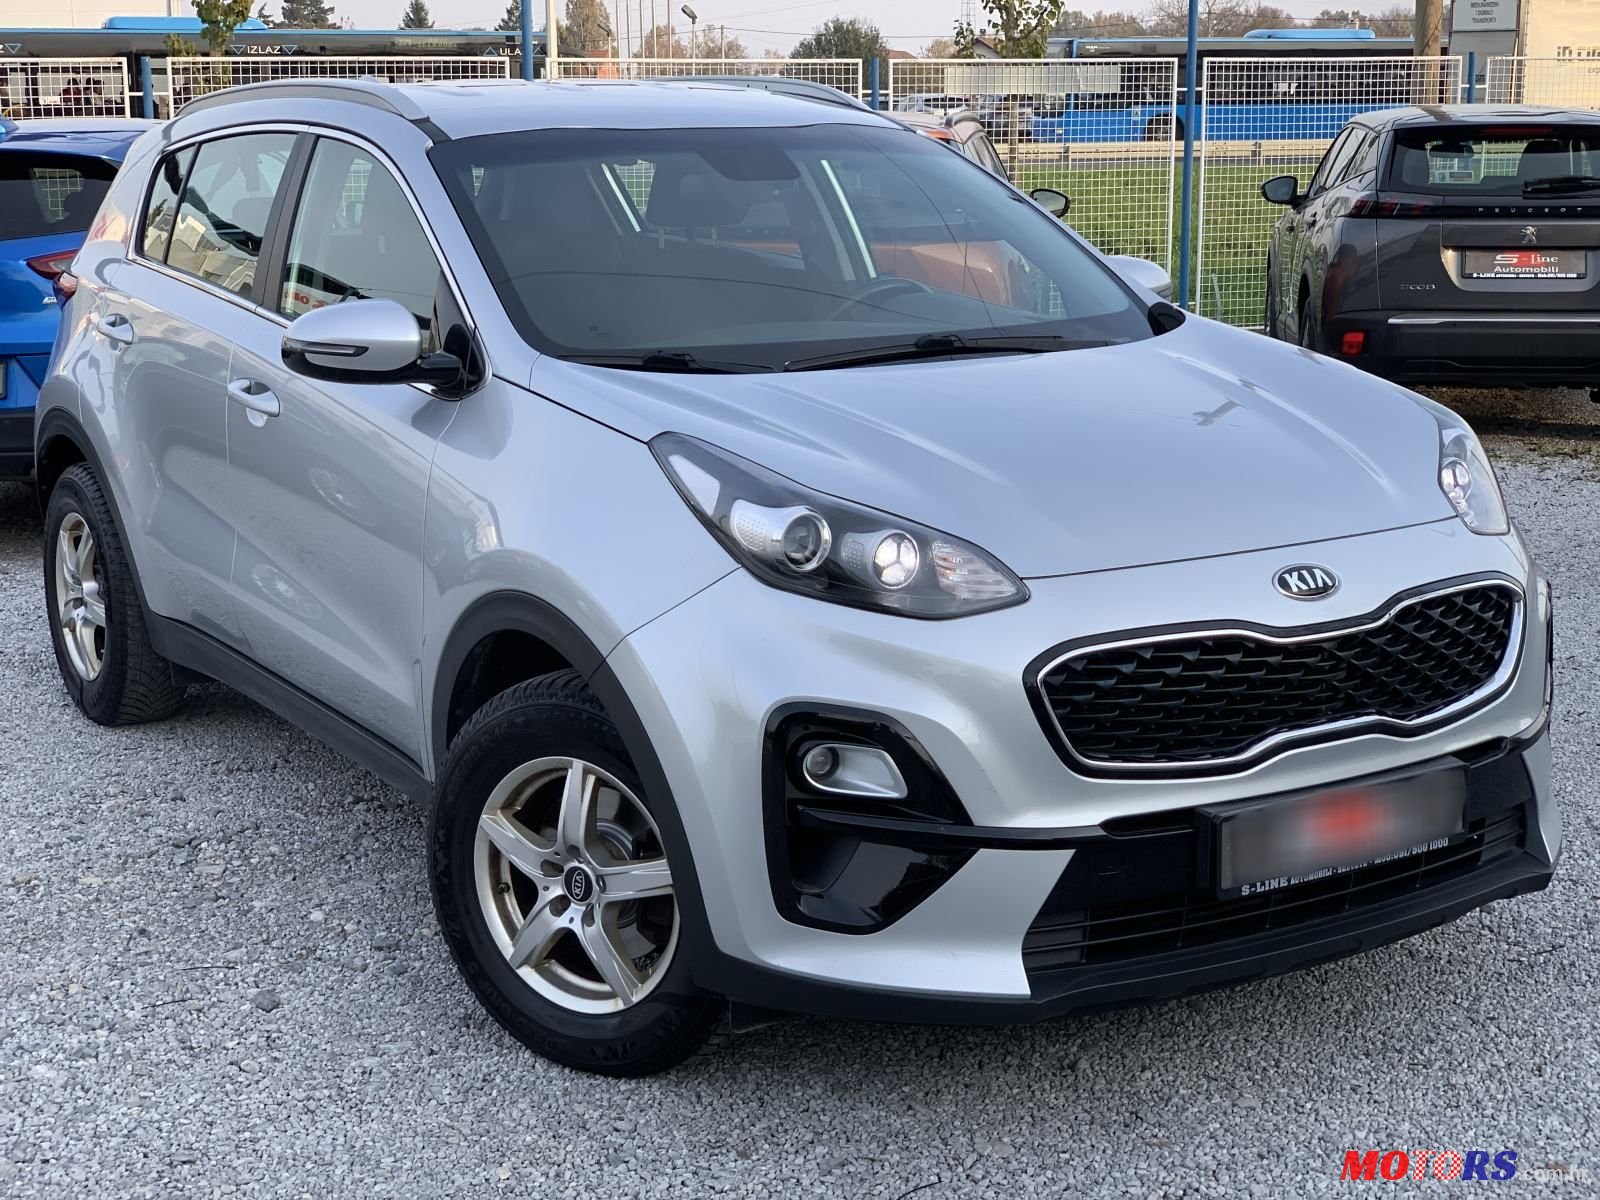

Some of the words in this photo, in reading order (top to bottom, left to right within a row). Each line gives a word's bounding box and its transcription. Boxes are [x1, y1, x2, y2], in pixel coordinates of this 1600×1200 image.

[247, 45, 281, 54] IZLAZ
[500, 47, 523, 56] ULA
[1493, 265, 1559, 273] Automobili
[1281, 567, 1334, 593] KIA
[1241, 876, 1288, 896] S-LINE
